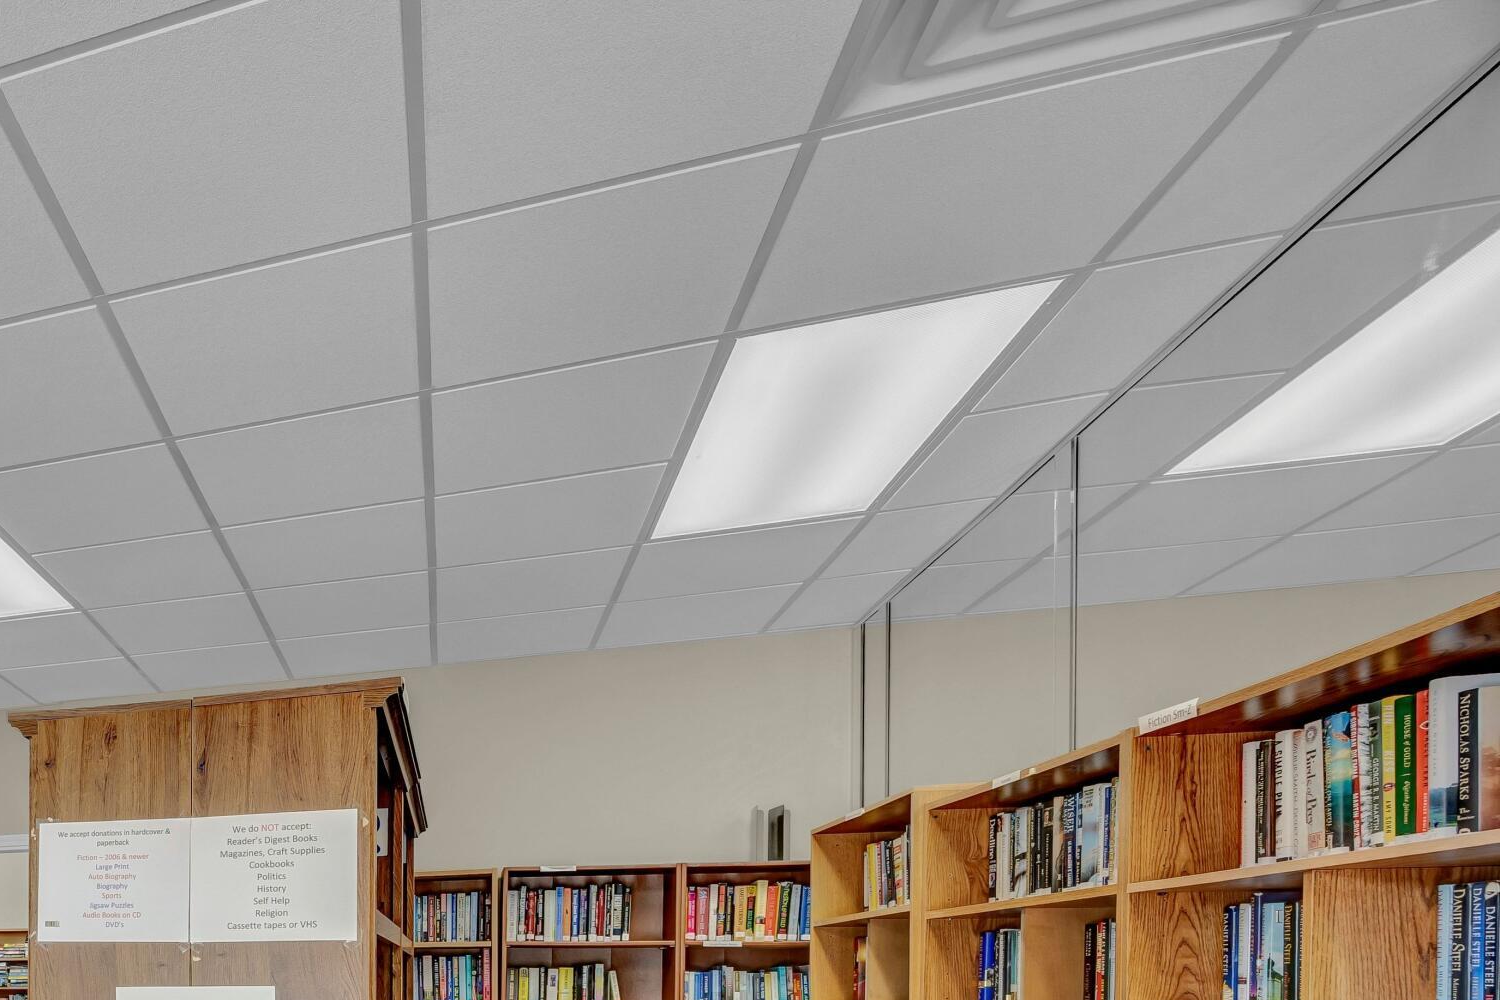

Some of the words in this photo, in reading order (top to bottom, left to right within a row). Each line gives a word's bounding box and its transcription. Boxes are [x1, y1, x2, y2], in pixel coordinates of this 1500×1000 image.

[1147, 708, 1171, 729] Fiction
[1403, 714, 1411, 739] HOUSE
[1459, 694, 1471, 754] NICHOLAS
[1306, 749, 1317, 782] Birds
[1459, 757, 1471, 800] SPARKS
[1067, 797, 1075, 834] WISER
[1275, 792, 1283, 818] PLAN
[1306, 798, 1317, 826] Prey
[227, 837, 262, 845] Reader's
[265, 836, 290, 845] Digest
[293, 835, 318, 843] Books
[261, 824, 279, 832] NOT
[281, 823, 312, 831] accept:
[97, 839, 129, 847] paperback
[220, 849, 265, 859] Magazines,
[268, 848, 288, 856] Craft
[290, 847, 325, 855] Supplies
[249, 860, 295, 869] Cookbooks
[254, 897, 269, 905] Self
[271, 897, 290, 905] Help
[257, 885, 287, 893] History
[227, 922, 262, 930] Cassette
[264, 922, 286, 930] tapes
[256, 909, 288, 918] Religion
[1284, 905, 1293, 942] DANIELLE
[1453, 888, 1466, 939] DANIELLE
[1473, 888, 1483, 938] DANIELLE
[1485, 906, 1496, 957] DANIELLE
[1284, 944, 1293, 965] STEEL
[1452, 943, 1466, 973] STEEL
[1472, 941, 1482, 969] STEEL
[1484, 960, 1494, 990] STEEL
